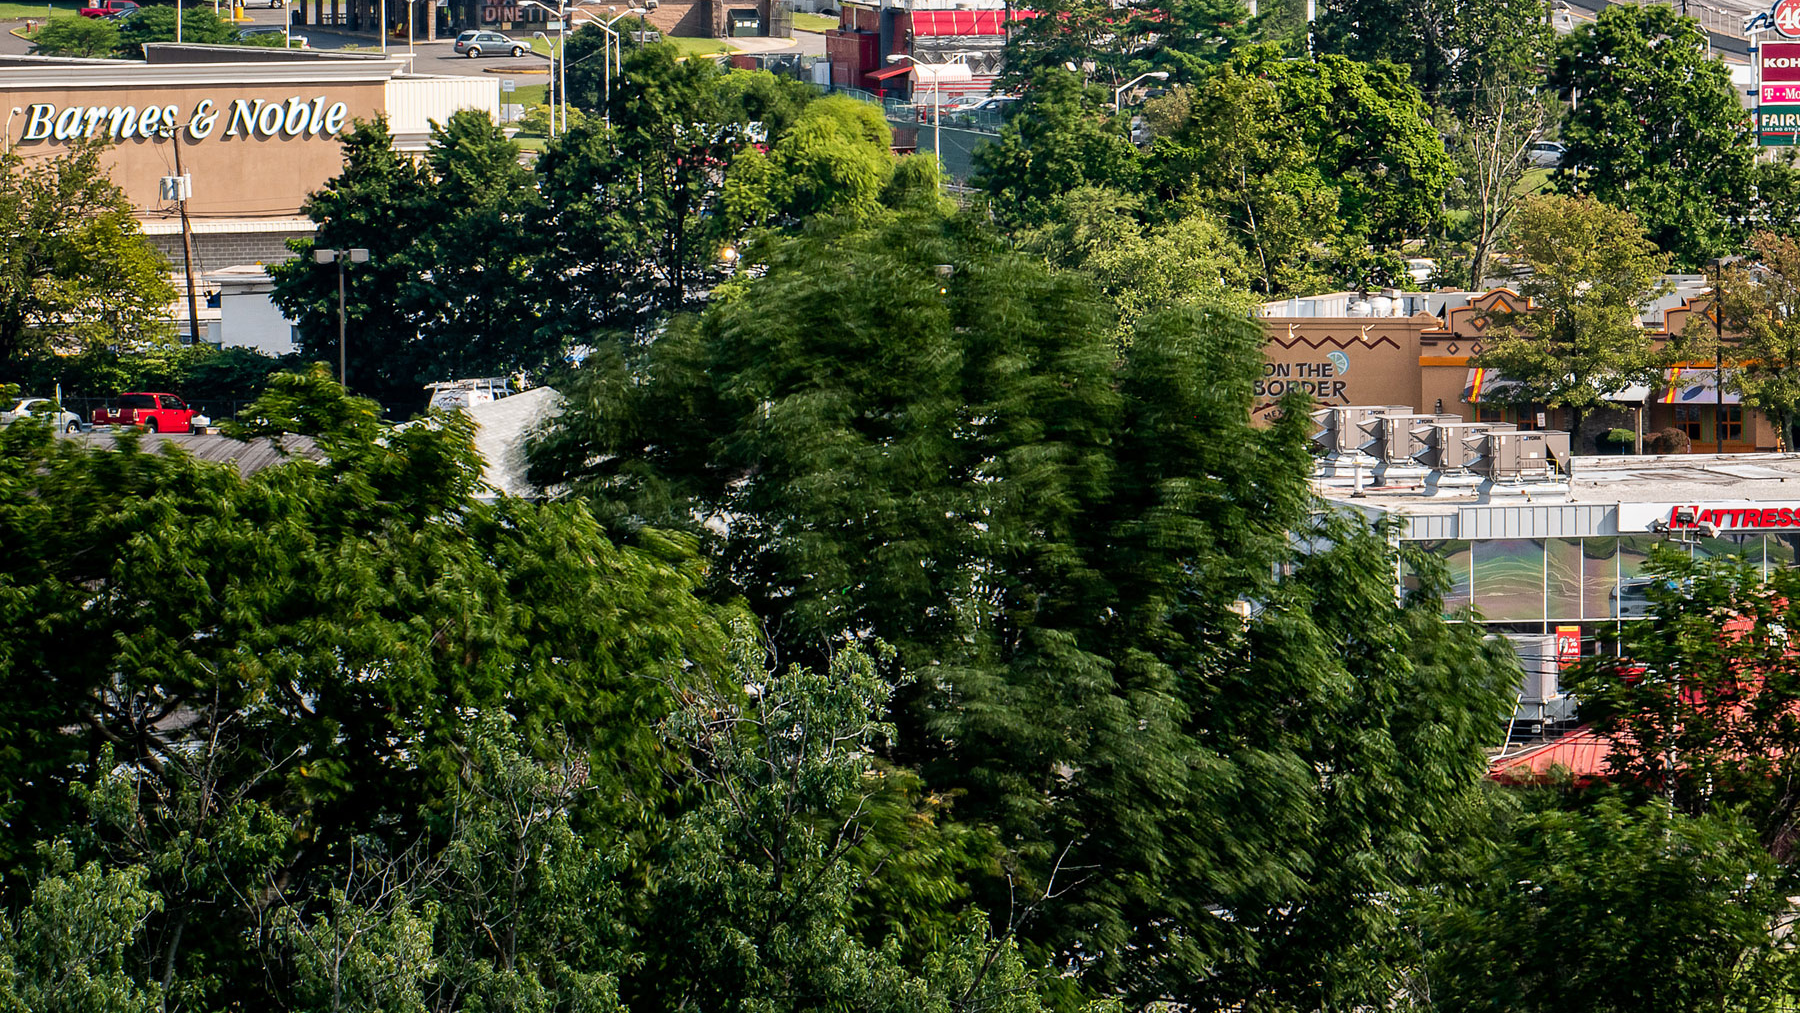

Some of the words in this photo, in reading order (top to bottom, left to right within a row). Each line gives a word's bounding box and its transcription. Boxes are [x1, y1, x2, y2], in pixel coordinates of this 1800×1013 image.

[23, 102, 180, 140] Barnes
[189, 98, 220, 139] &
[226, 95, 348, 136] Noble
[1263, 362, 1291, 378] ON
[1295, 362, 1334, 378] THE
[1253, 379, 1351, 405] BORDER
[1263, 408, 1284, 420] MEX
